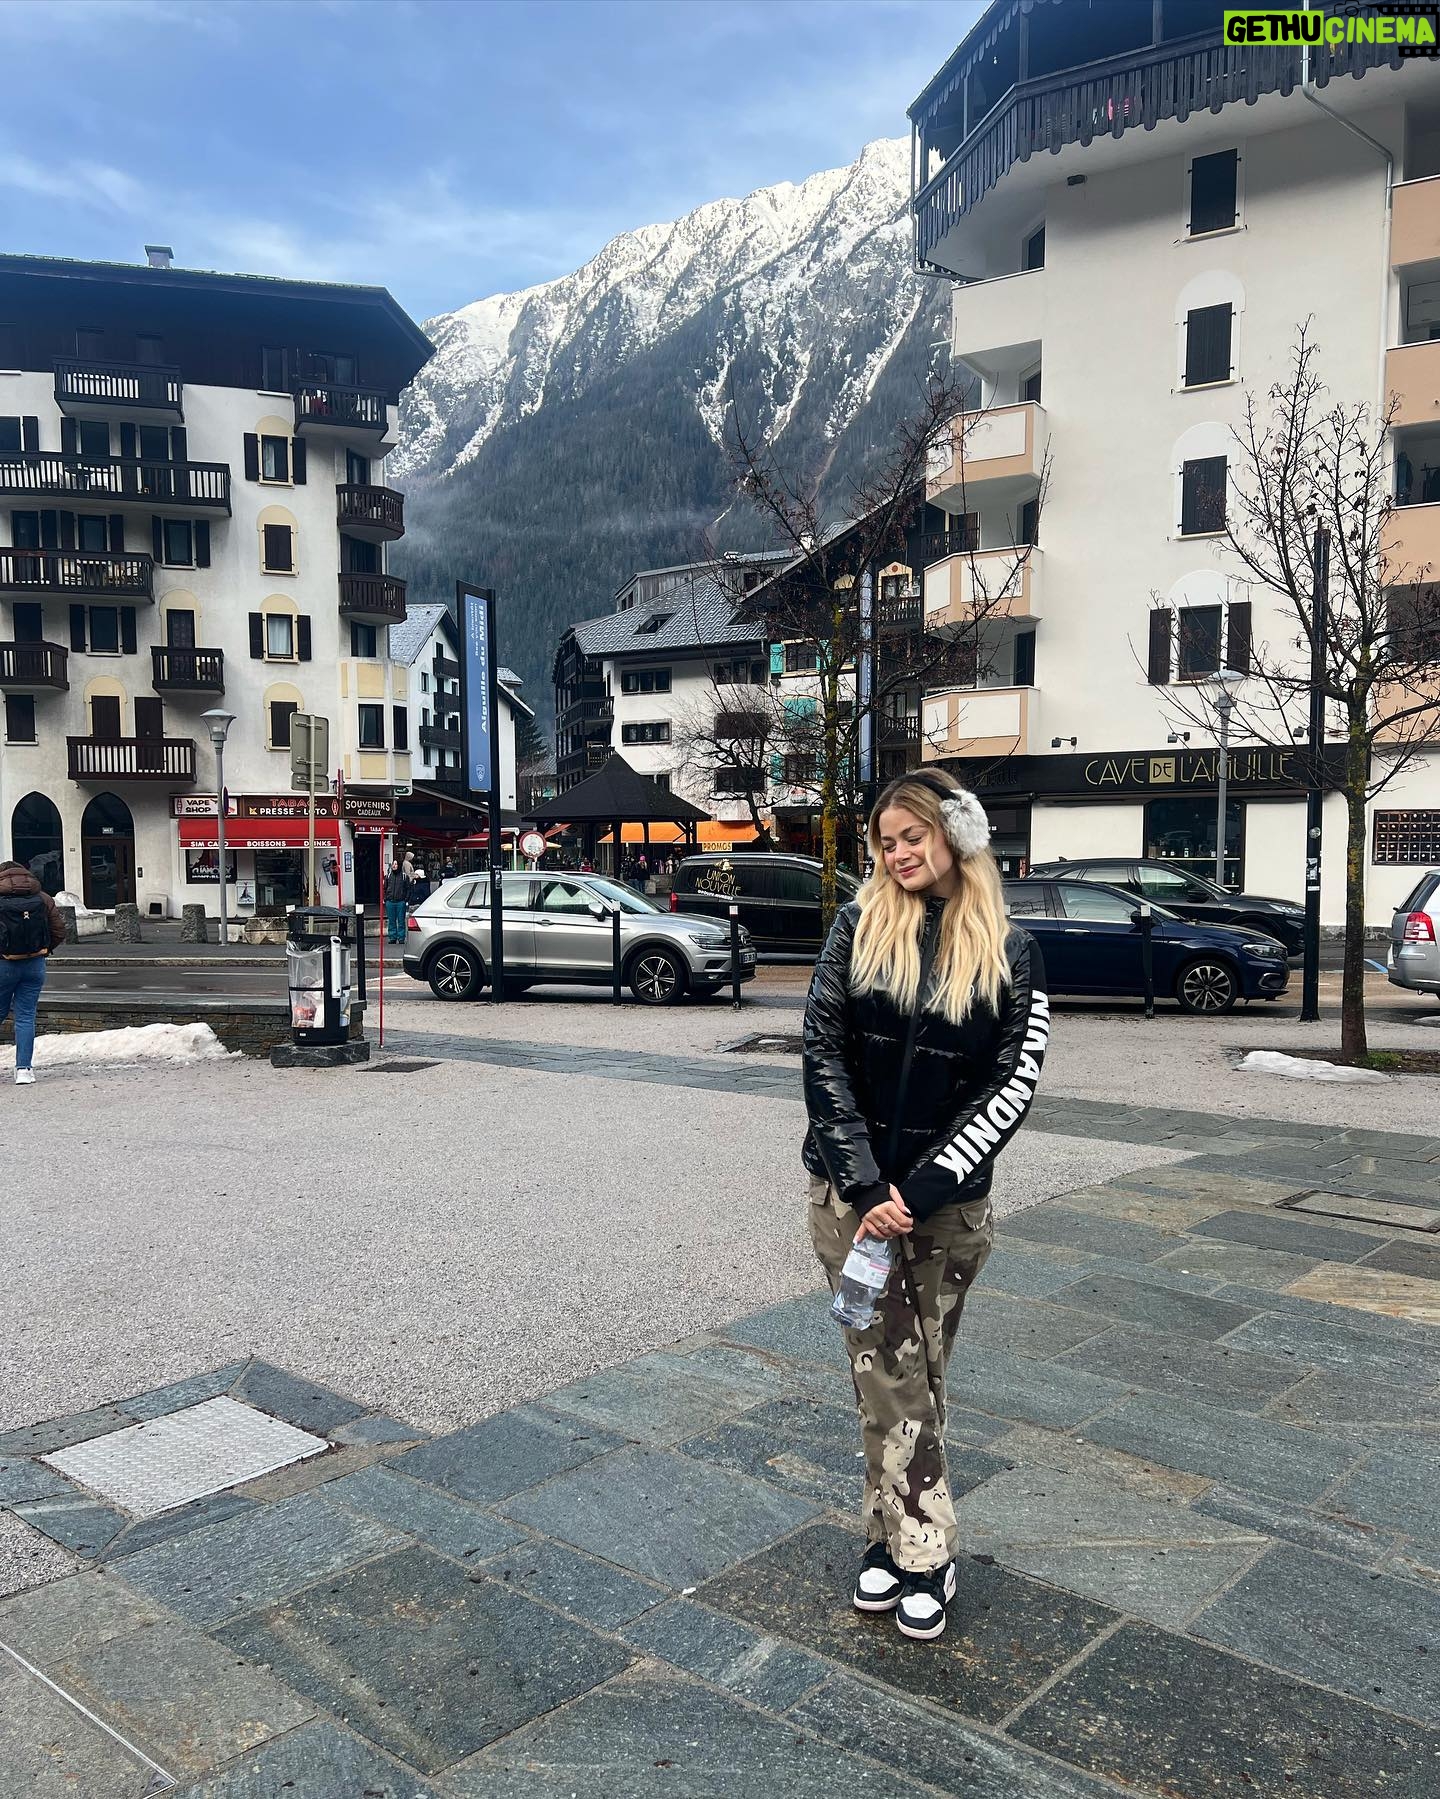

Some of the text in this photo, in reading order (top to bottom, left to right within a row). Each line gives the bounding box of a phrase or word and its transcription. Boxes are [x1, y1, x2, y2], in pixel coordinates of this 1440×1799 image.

[479, 646, 486, 667] du
[480, 671, 488, 733] Aiguille
[1085, 758, 1145, 785] CAVE
[1152, 762, 1173, 779] DE
[345, 800, 391, 812] SOUVENIRS
[703, 842, 732, 851] PROMOS
[695, 877, 742, 897] NOUVELLE
[706, 869, 736, 885] UNION
